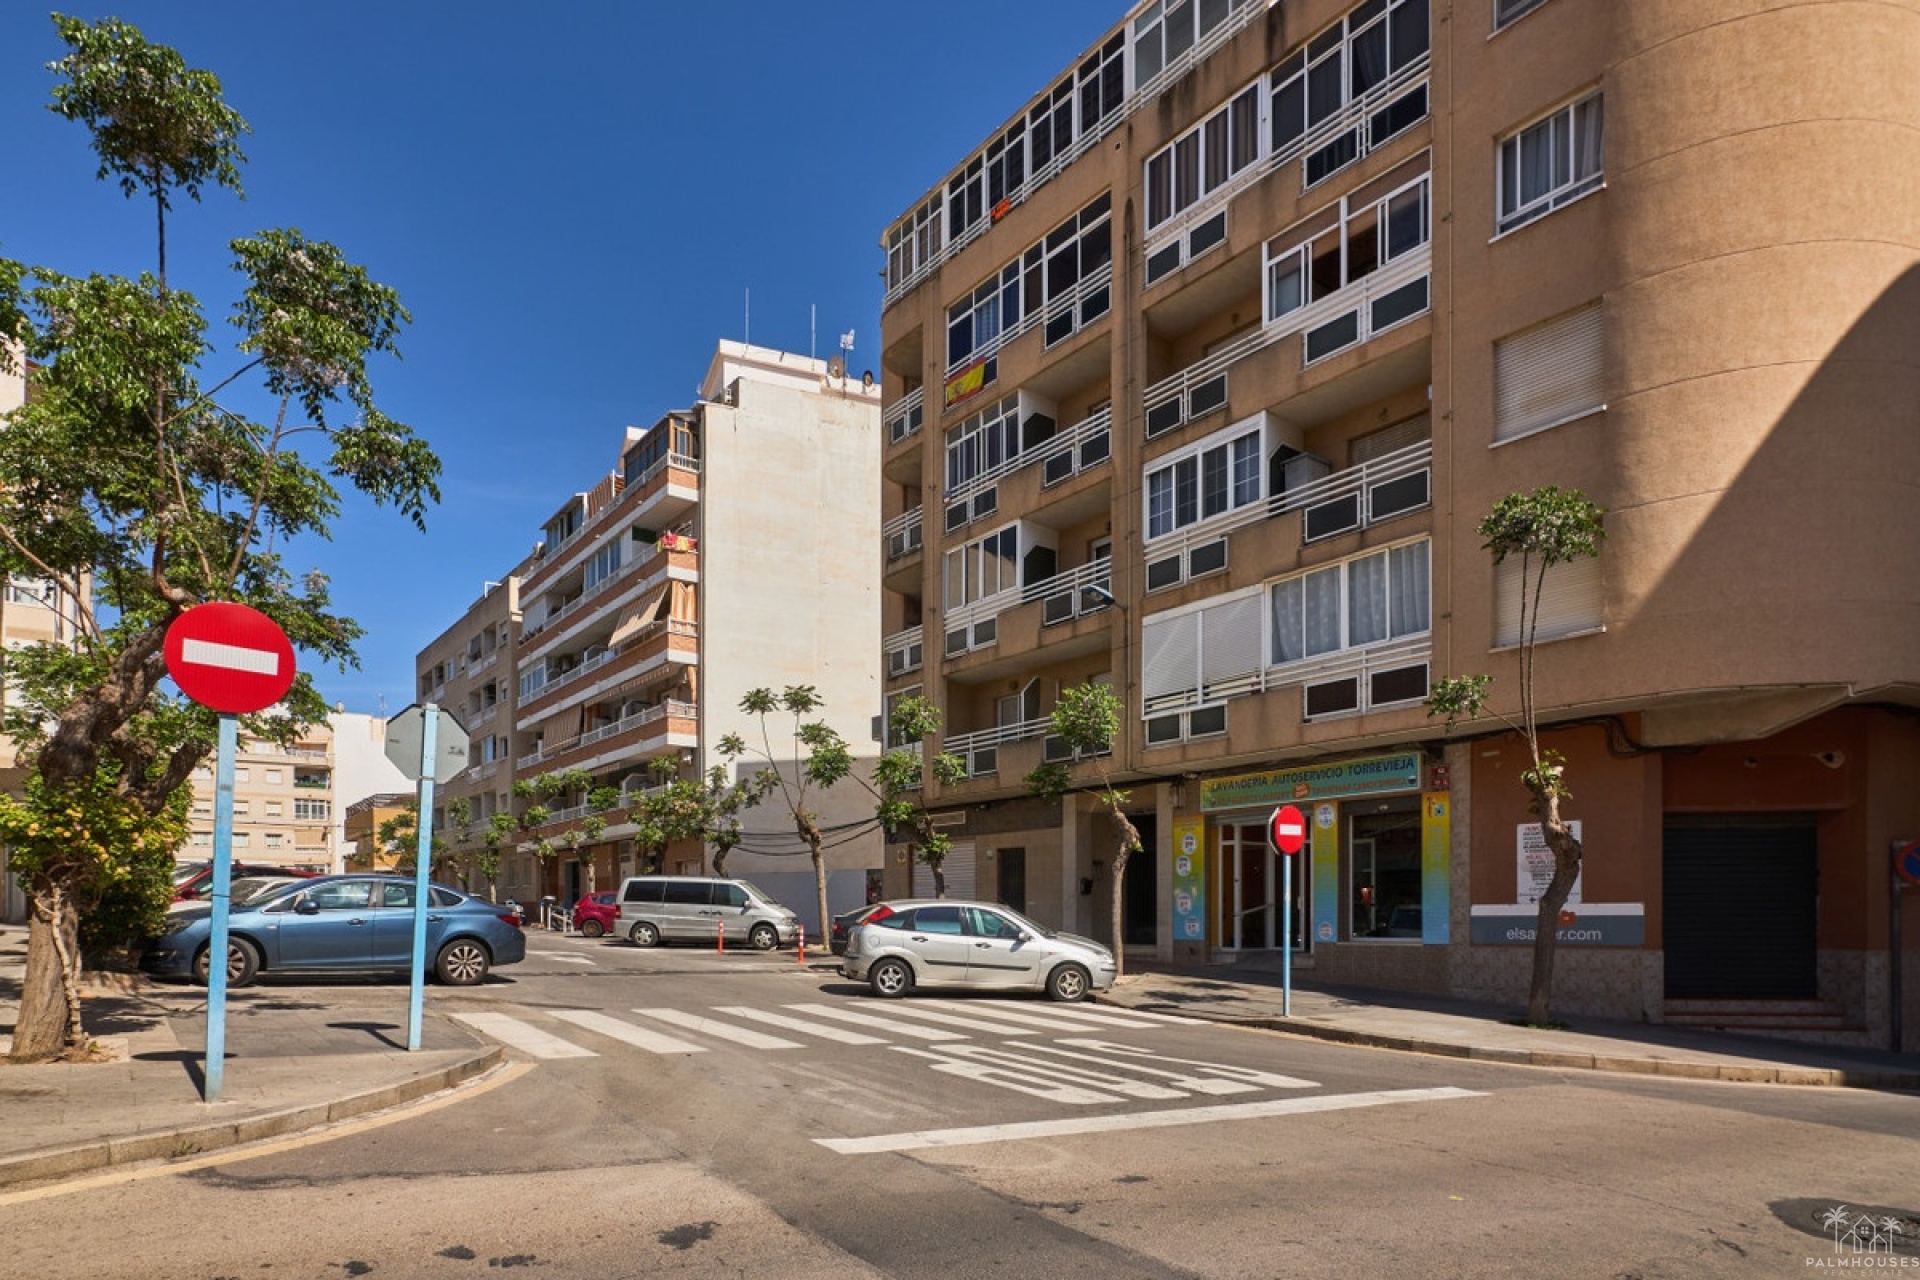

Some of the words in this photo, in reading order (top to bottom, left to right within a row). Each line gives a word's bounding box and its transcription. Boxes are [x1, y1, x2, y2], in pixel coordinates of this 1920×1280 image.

[1271, 766, 1343, 786] AUTOSERVICIO
[1347, 757, 1415, 777] TORREVIEJA
[887, 1038, 1322, 1104] STOP
